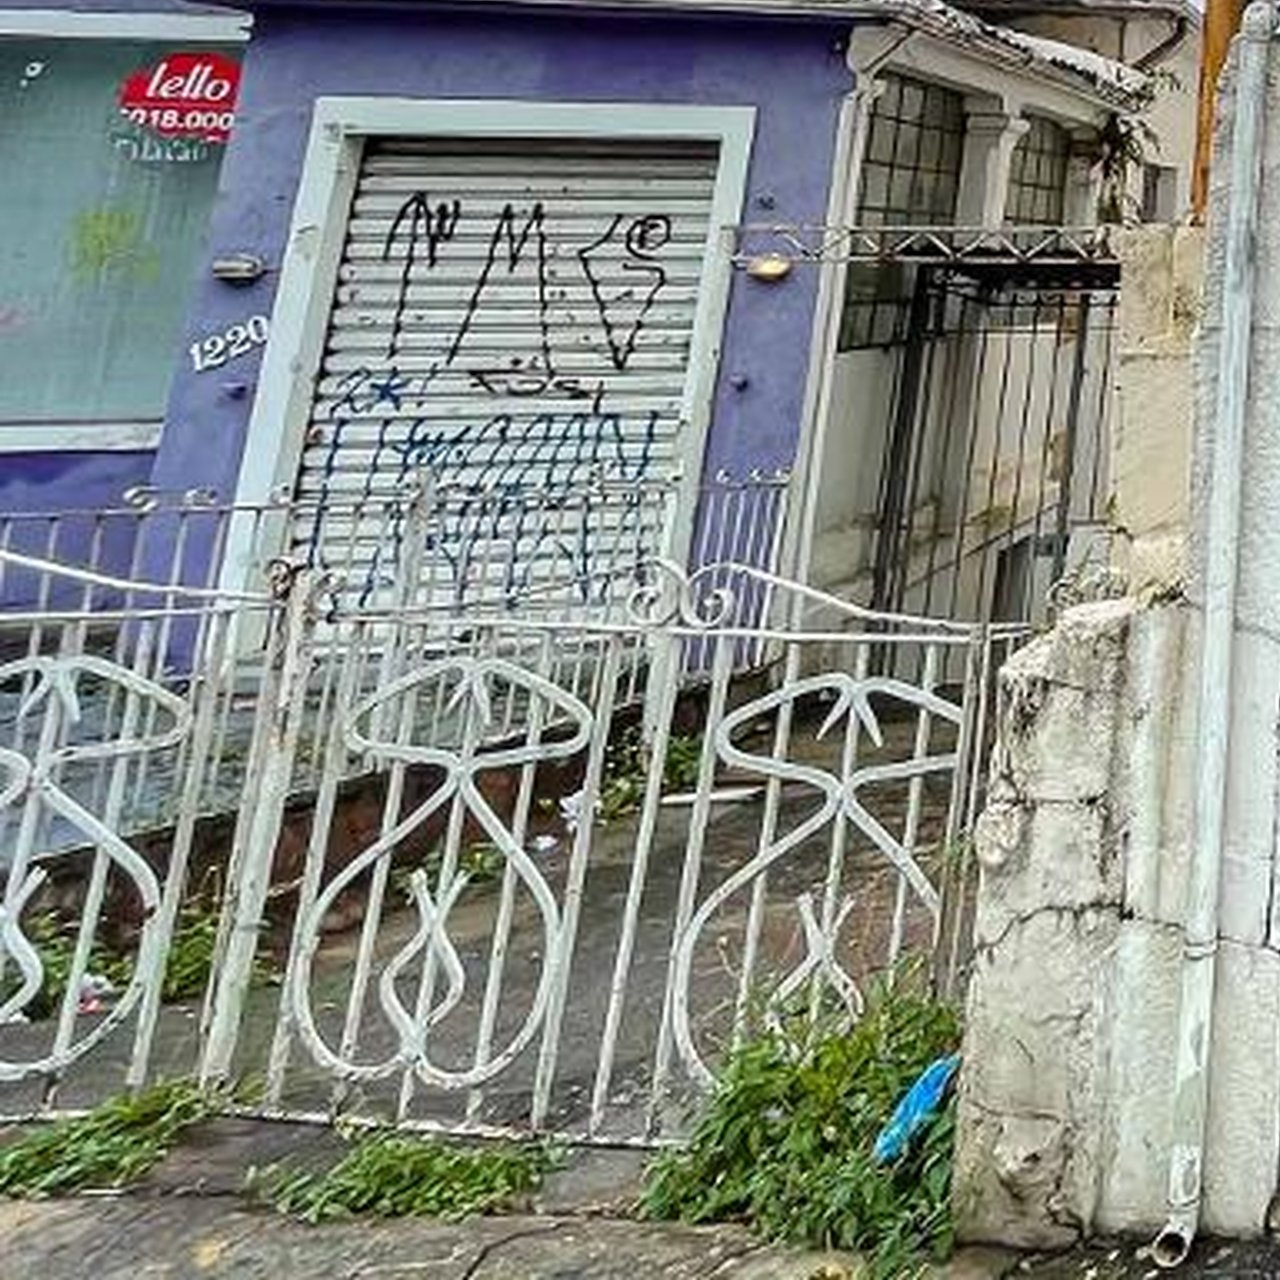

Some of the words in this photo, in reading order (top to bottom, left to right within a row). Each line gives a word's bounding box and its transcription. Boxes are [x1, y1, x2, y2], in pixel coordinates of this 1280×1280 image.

[145, 62, 231, 101] lello
[120, 107, 235, 131] 018.000
[190, 315, 269, 372] 1220
